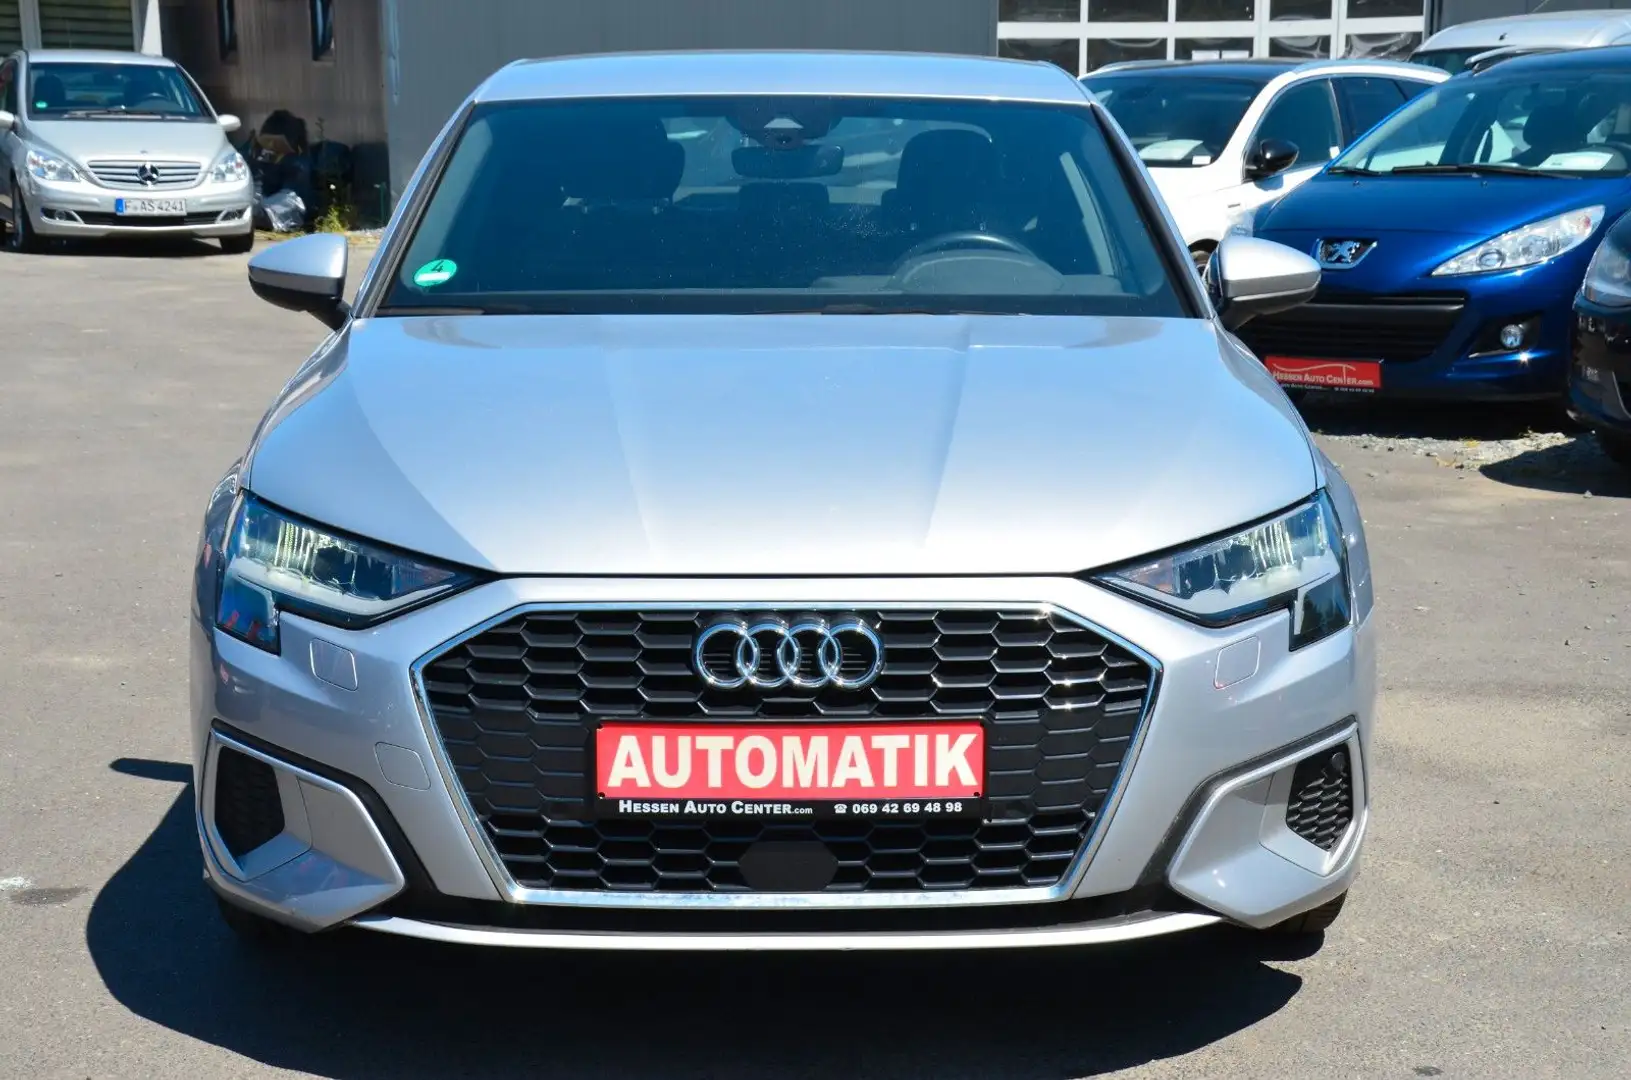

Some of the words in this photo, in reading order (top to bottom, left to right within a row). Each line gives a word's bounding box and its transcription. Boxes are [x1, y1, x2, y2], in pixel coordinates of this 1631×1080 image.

[141, 201, 155, 212] AS
[157, 201, 184, 212] 4241
[1304, 373, 1324, 384] AUTO
[607, 733, 978, 789] AUTOMATIK
[618, 800, 680, 815] HESSEN
[683, 800, 728, 815] AUTO
[852, 803, 878, 815] 069
[882, 803, 900, 814] 42
[903, 803, 920, 814] 69
[924, 802, 941, 813] 48
[945, 801, 963, 813] 98
